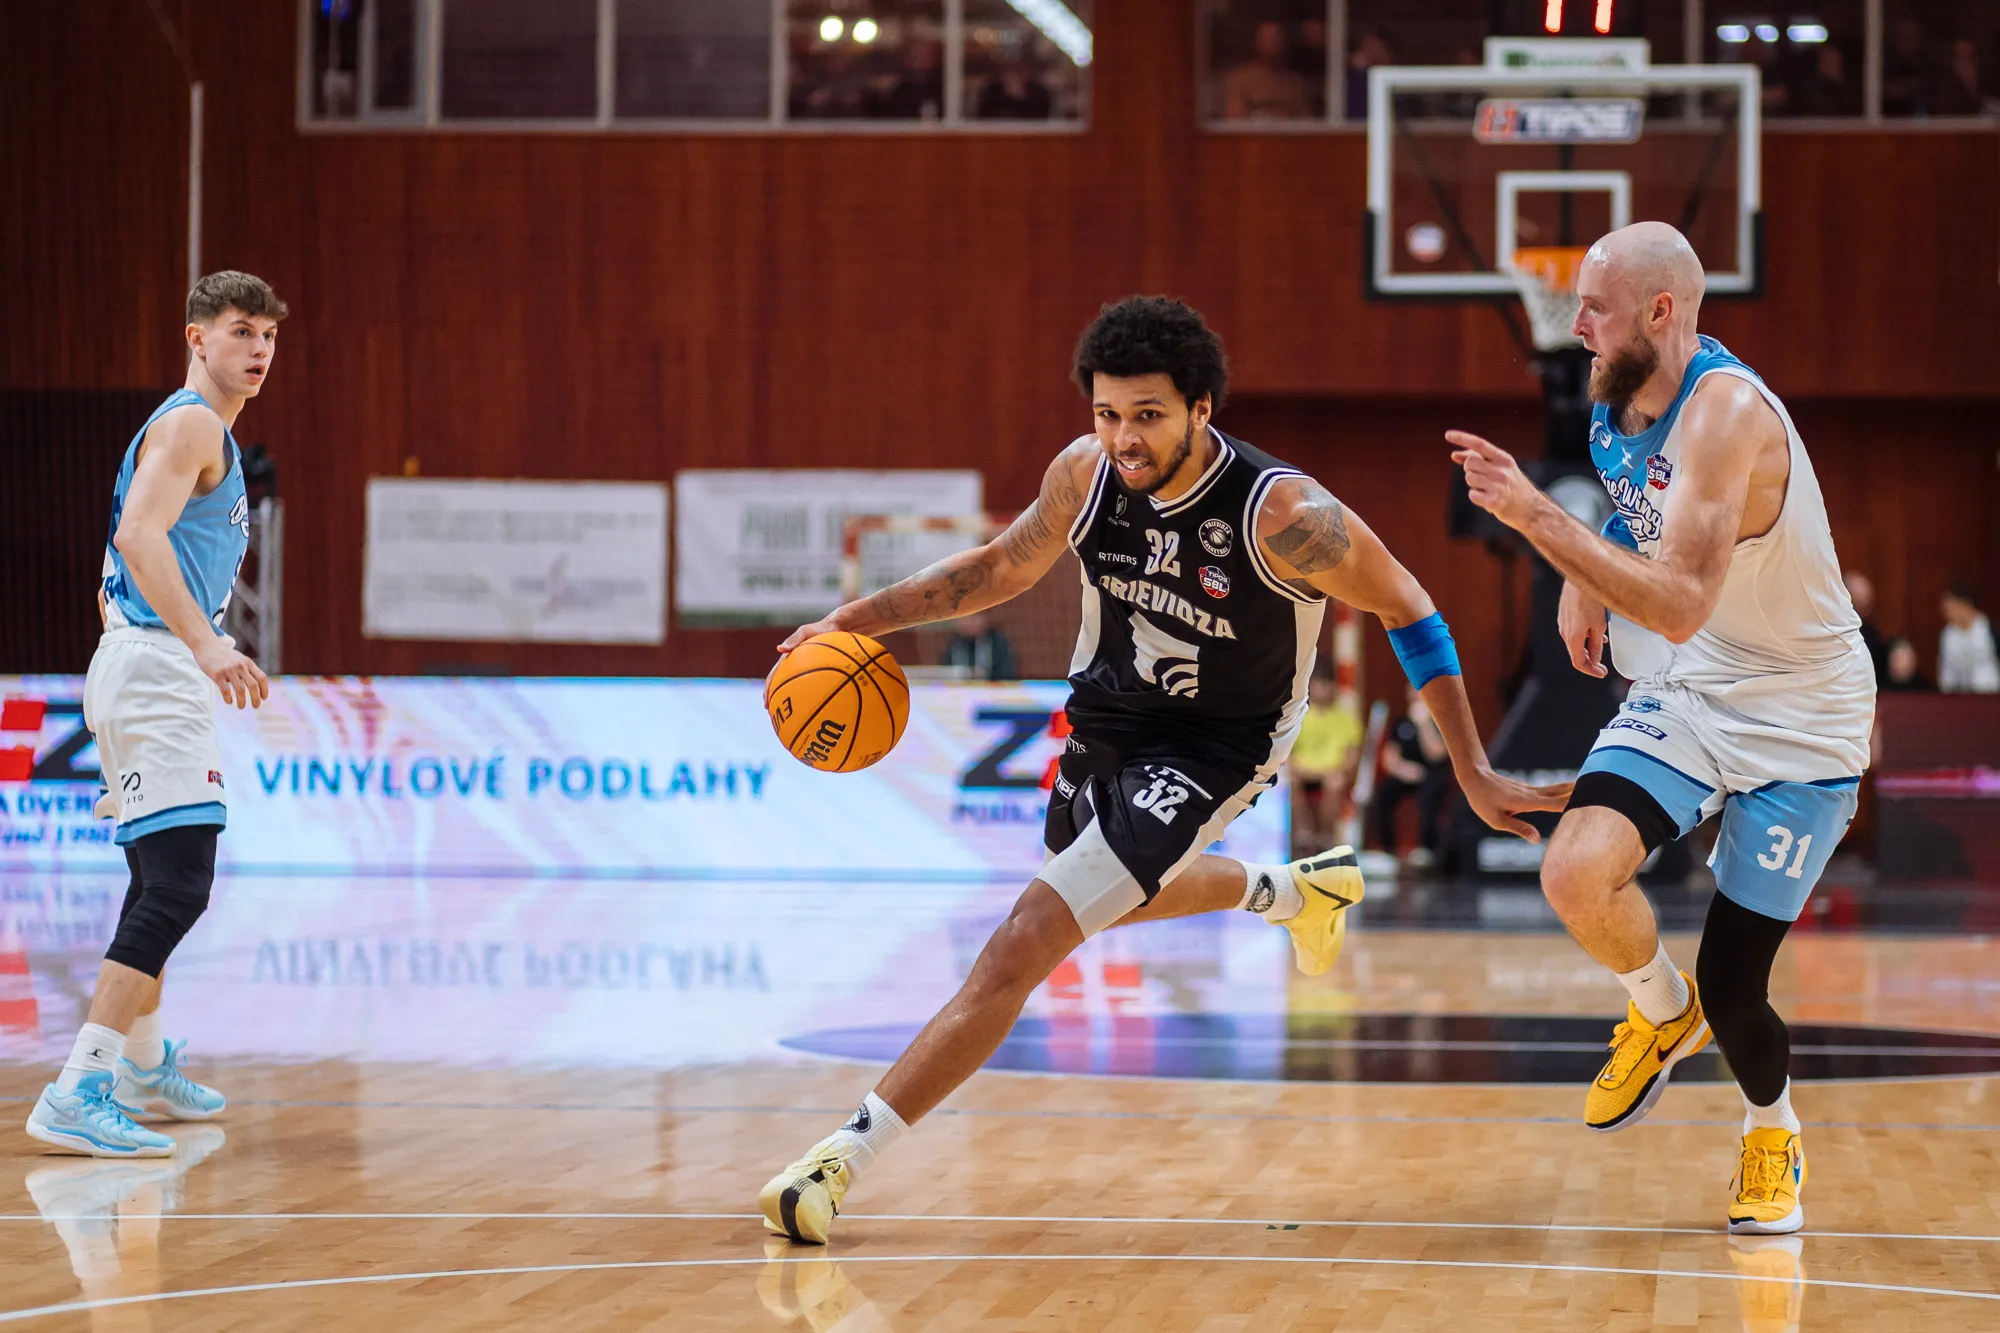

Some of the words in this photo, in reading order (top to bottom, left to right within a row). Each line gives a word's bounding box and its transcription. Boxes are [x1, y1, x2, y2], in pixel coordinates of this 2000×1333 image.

[1647, 468, 1669, 484] SBL
[1618, 476, 1663, 541] Wing
[1098, 551, 1138, 566] RTNERS
[1144, 528, 1181, 578] 32
[1202, 577, 1228, 594] SBL
[1207, 570, 1229, 584] TIPOS
[1605, 718, 1664, 739] TIPOS
[255, 746, 507, 798] VINYLOVÉ
[526, 754, 773, 799] PODLAHY
[1055, 771, 1076, 798] TIP
[1132, 777, 1190, 826] 32
[1756, 824, 1813, 880] 31
